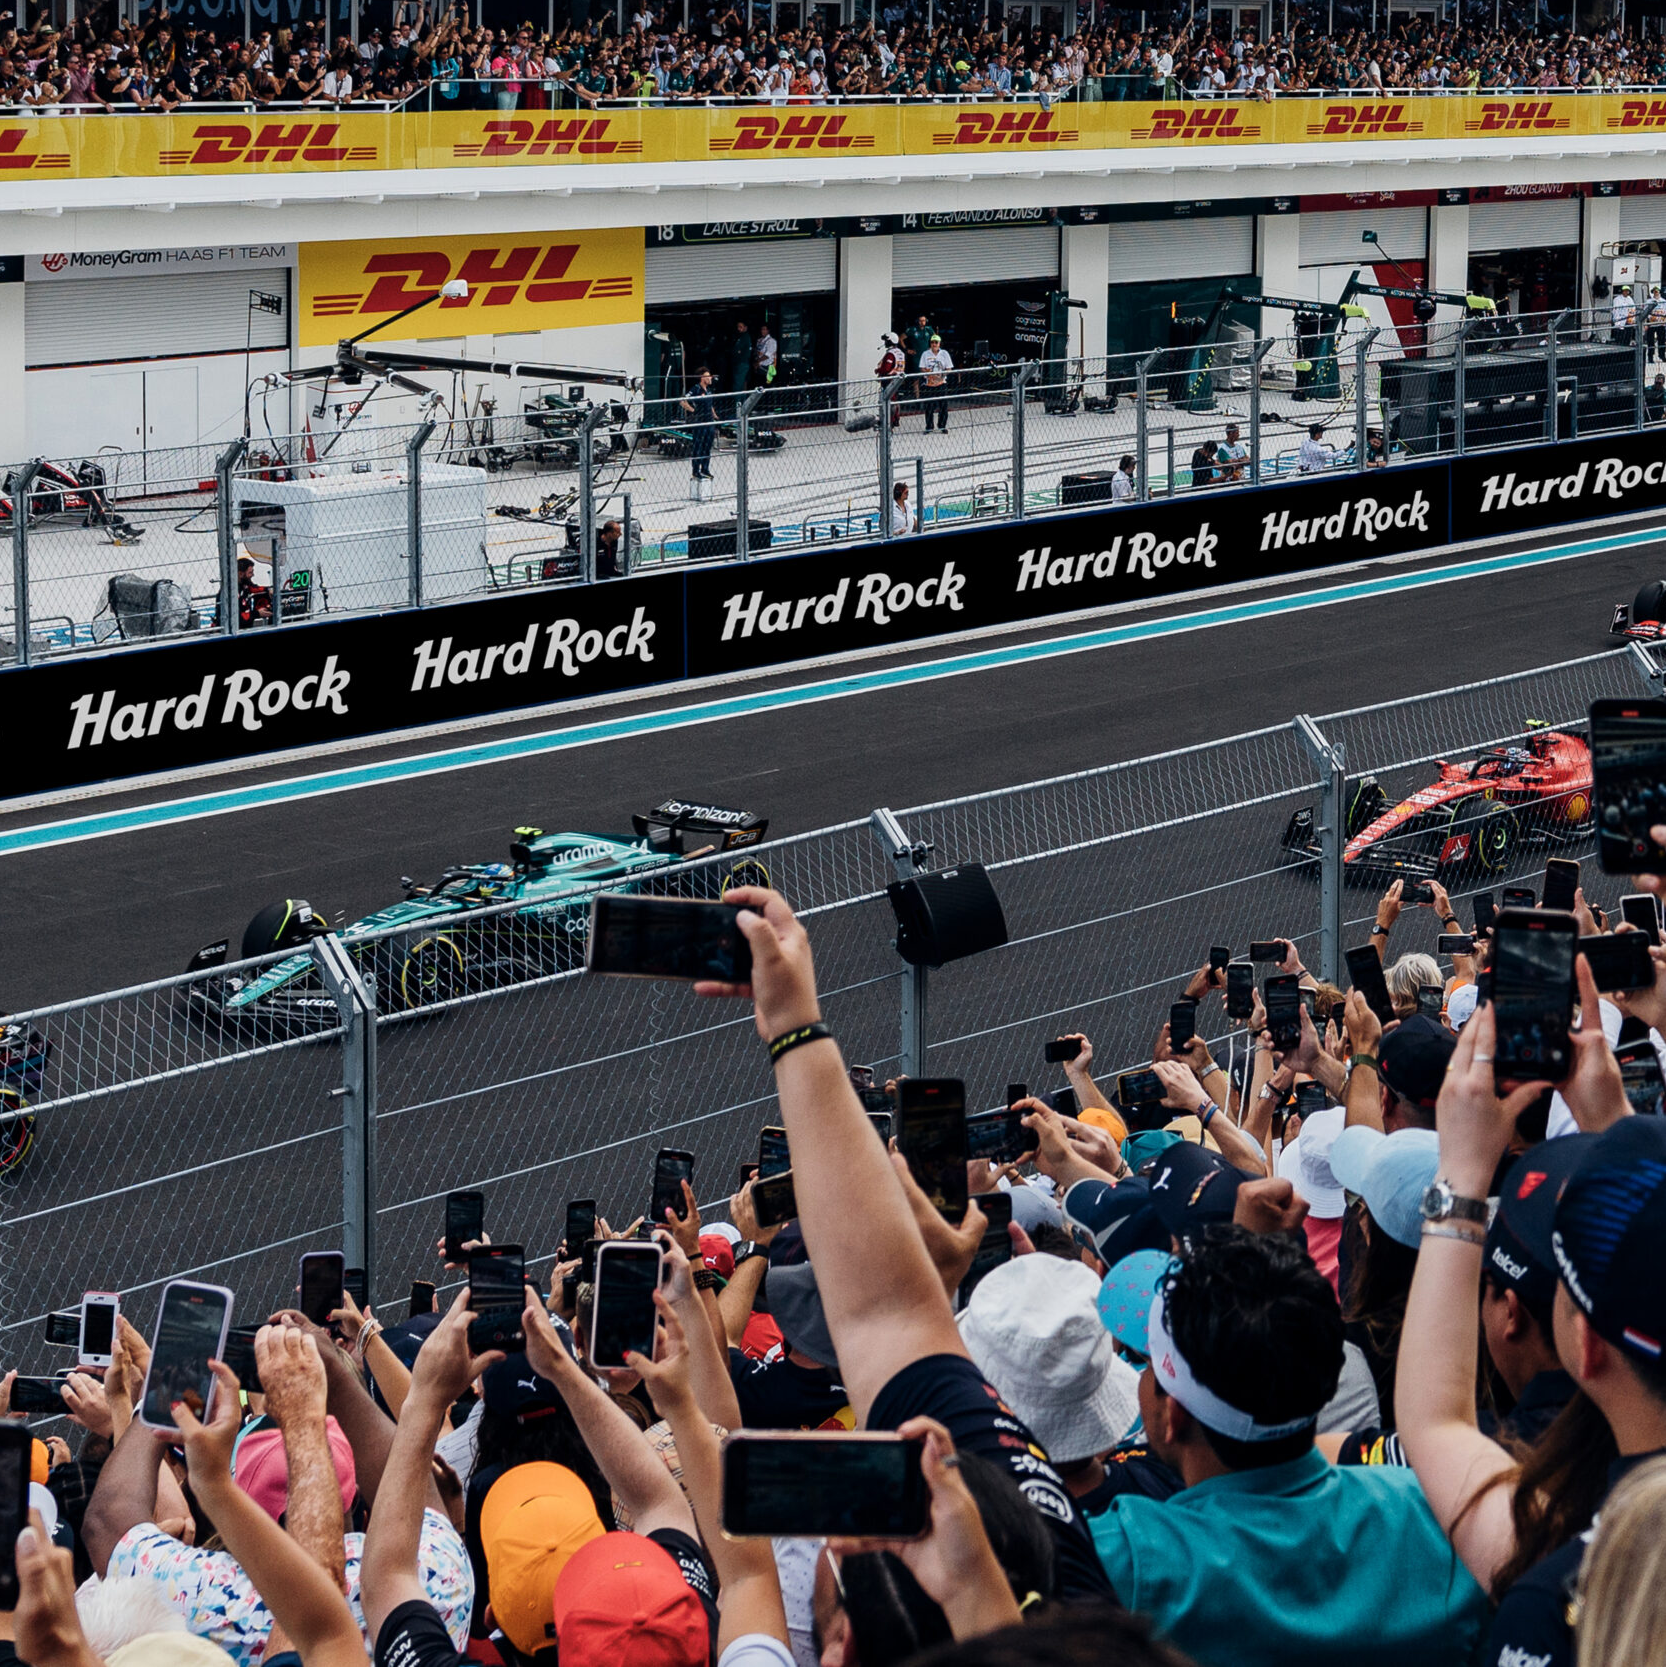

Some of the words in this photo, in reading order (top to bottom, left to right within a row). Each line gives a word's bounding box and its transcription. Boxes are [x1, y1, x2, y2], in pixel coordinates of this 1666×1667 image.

[955, 112, 1058, 144] DHL
[1152, 109, 1243, 138] DHL
[1324, 104, 1408, 133] DHL
[1481, 102, 1555, 130] DHL
[191, 124, 347, 164] DHL
[483, 120, 617, 156] DHL
[734, 116, 851, 149] DHL
[1504, 185, 1528, 195] ZHOU
[702, 221, 749, 236] LANCE
[750, 219, 800, 234] STROLL
[902, 212, 918, 229] 14
[927, 209, 993, 225] FERNANDO
[994, 207, 1043, 221] ALONSO
[656, 223, 674, 242] 18
[70, 249, 162, 270] MoneyGram
[166, 248, 213, 262] HAAS
[217, 247, 234, 260] F1
[240, 245, 286, 260] TEAM
[359, 244, 593, 314] DHL
[1015, 333, 1046, 344] aramco
[1481, 462, 1589, 512] Hard
[1260, 501, 1349, 551] Hard
[1352, 490, 1429, 541] Rock
[1016, 536, 1122, 591] Hard
[1127, 523, 1218, 579] Rock
[292, 571, 310, 587] 20
[721, 578, 850, 640] Hard
[855, 562, 965, 624] Rock
[411, 623, 539, 691] Hard
[544, 607, 655, 676] Rock
[68, 675, 215, 749] Hard
[221, 655, 350, 730] Rock
[668, 801, 748, 824] cognizant
[631, 839, 650, 855] 14
[730, 831, 757, 846] JCB
[553, 841, 615, 866] aramco
[635, 857, 670, 872] crypto.com
[1491, 1246, 1529, 1281] telcel
[1552, 1230, 1593, 1314] CarNext
[1027, 1487, 1066, 1516] Esso
